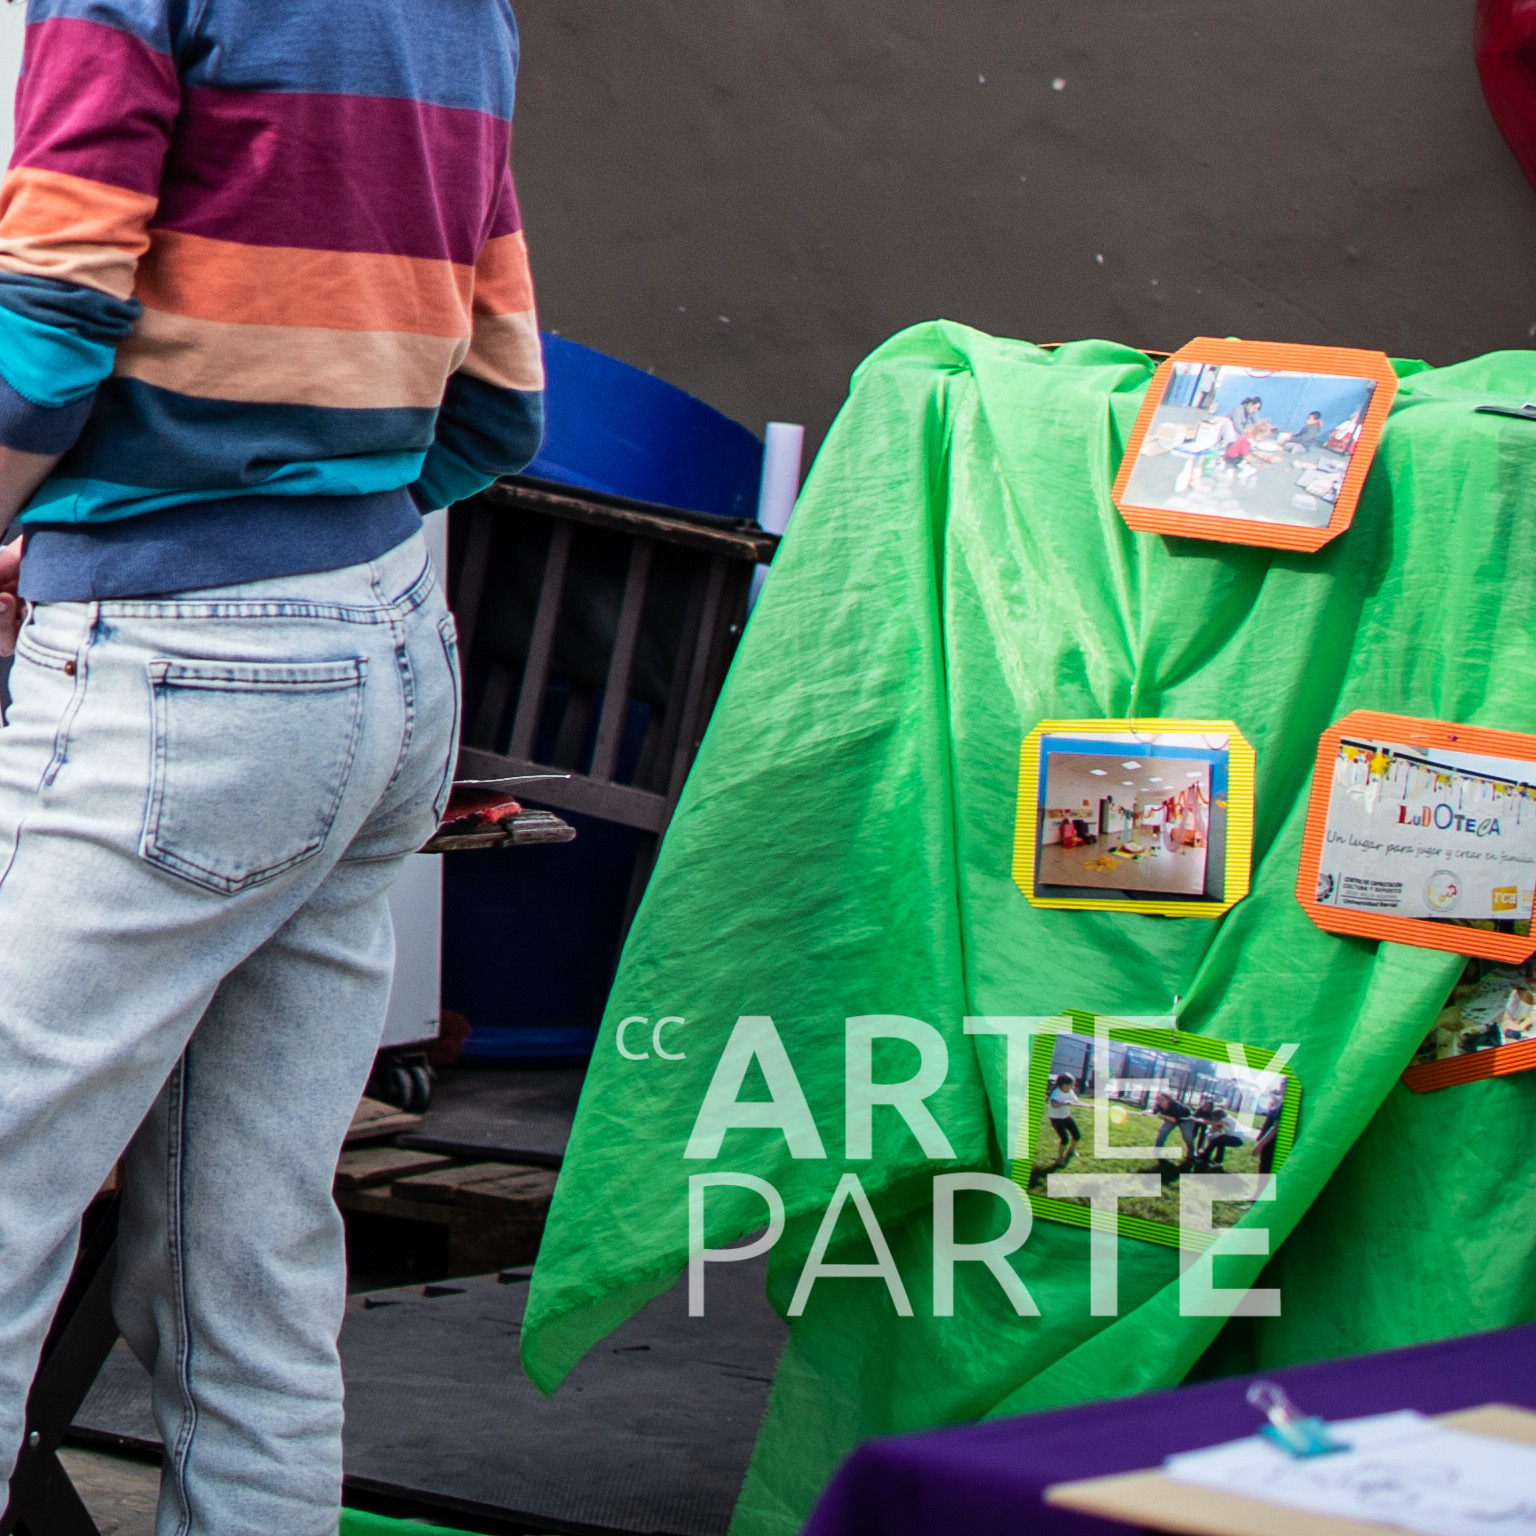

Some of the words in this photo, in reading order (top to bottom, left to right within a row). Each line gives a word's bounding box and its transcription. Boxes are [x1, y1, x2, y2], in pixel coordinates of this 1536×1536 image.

[1385, 842, 1414, 856] para
[1415, 843, 1442, 858] jugar
[1446, 848, 1452, 860] y
[1484, 851, 1498, 862] en
